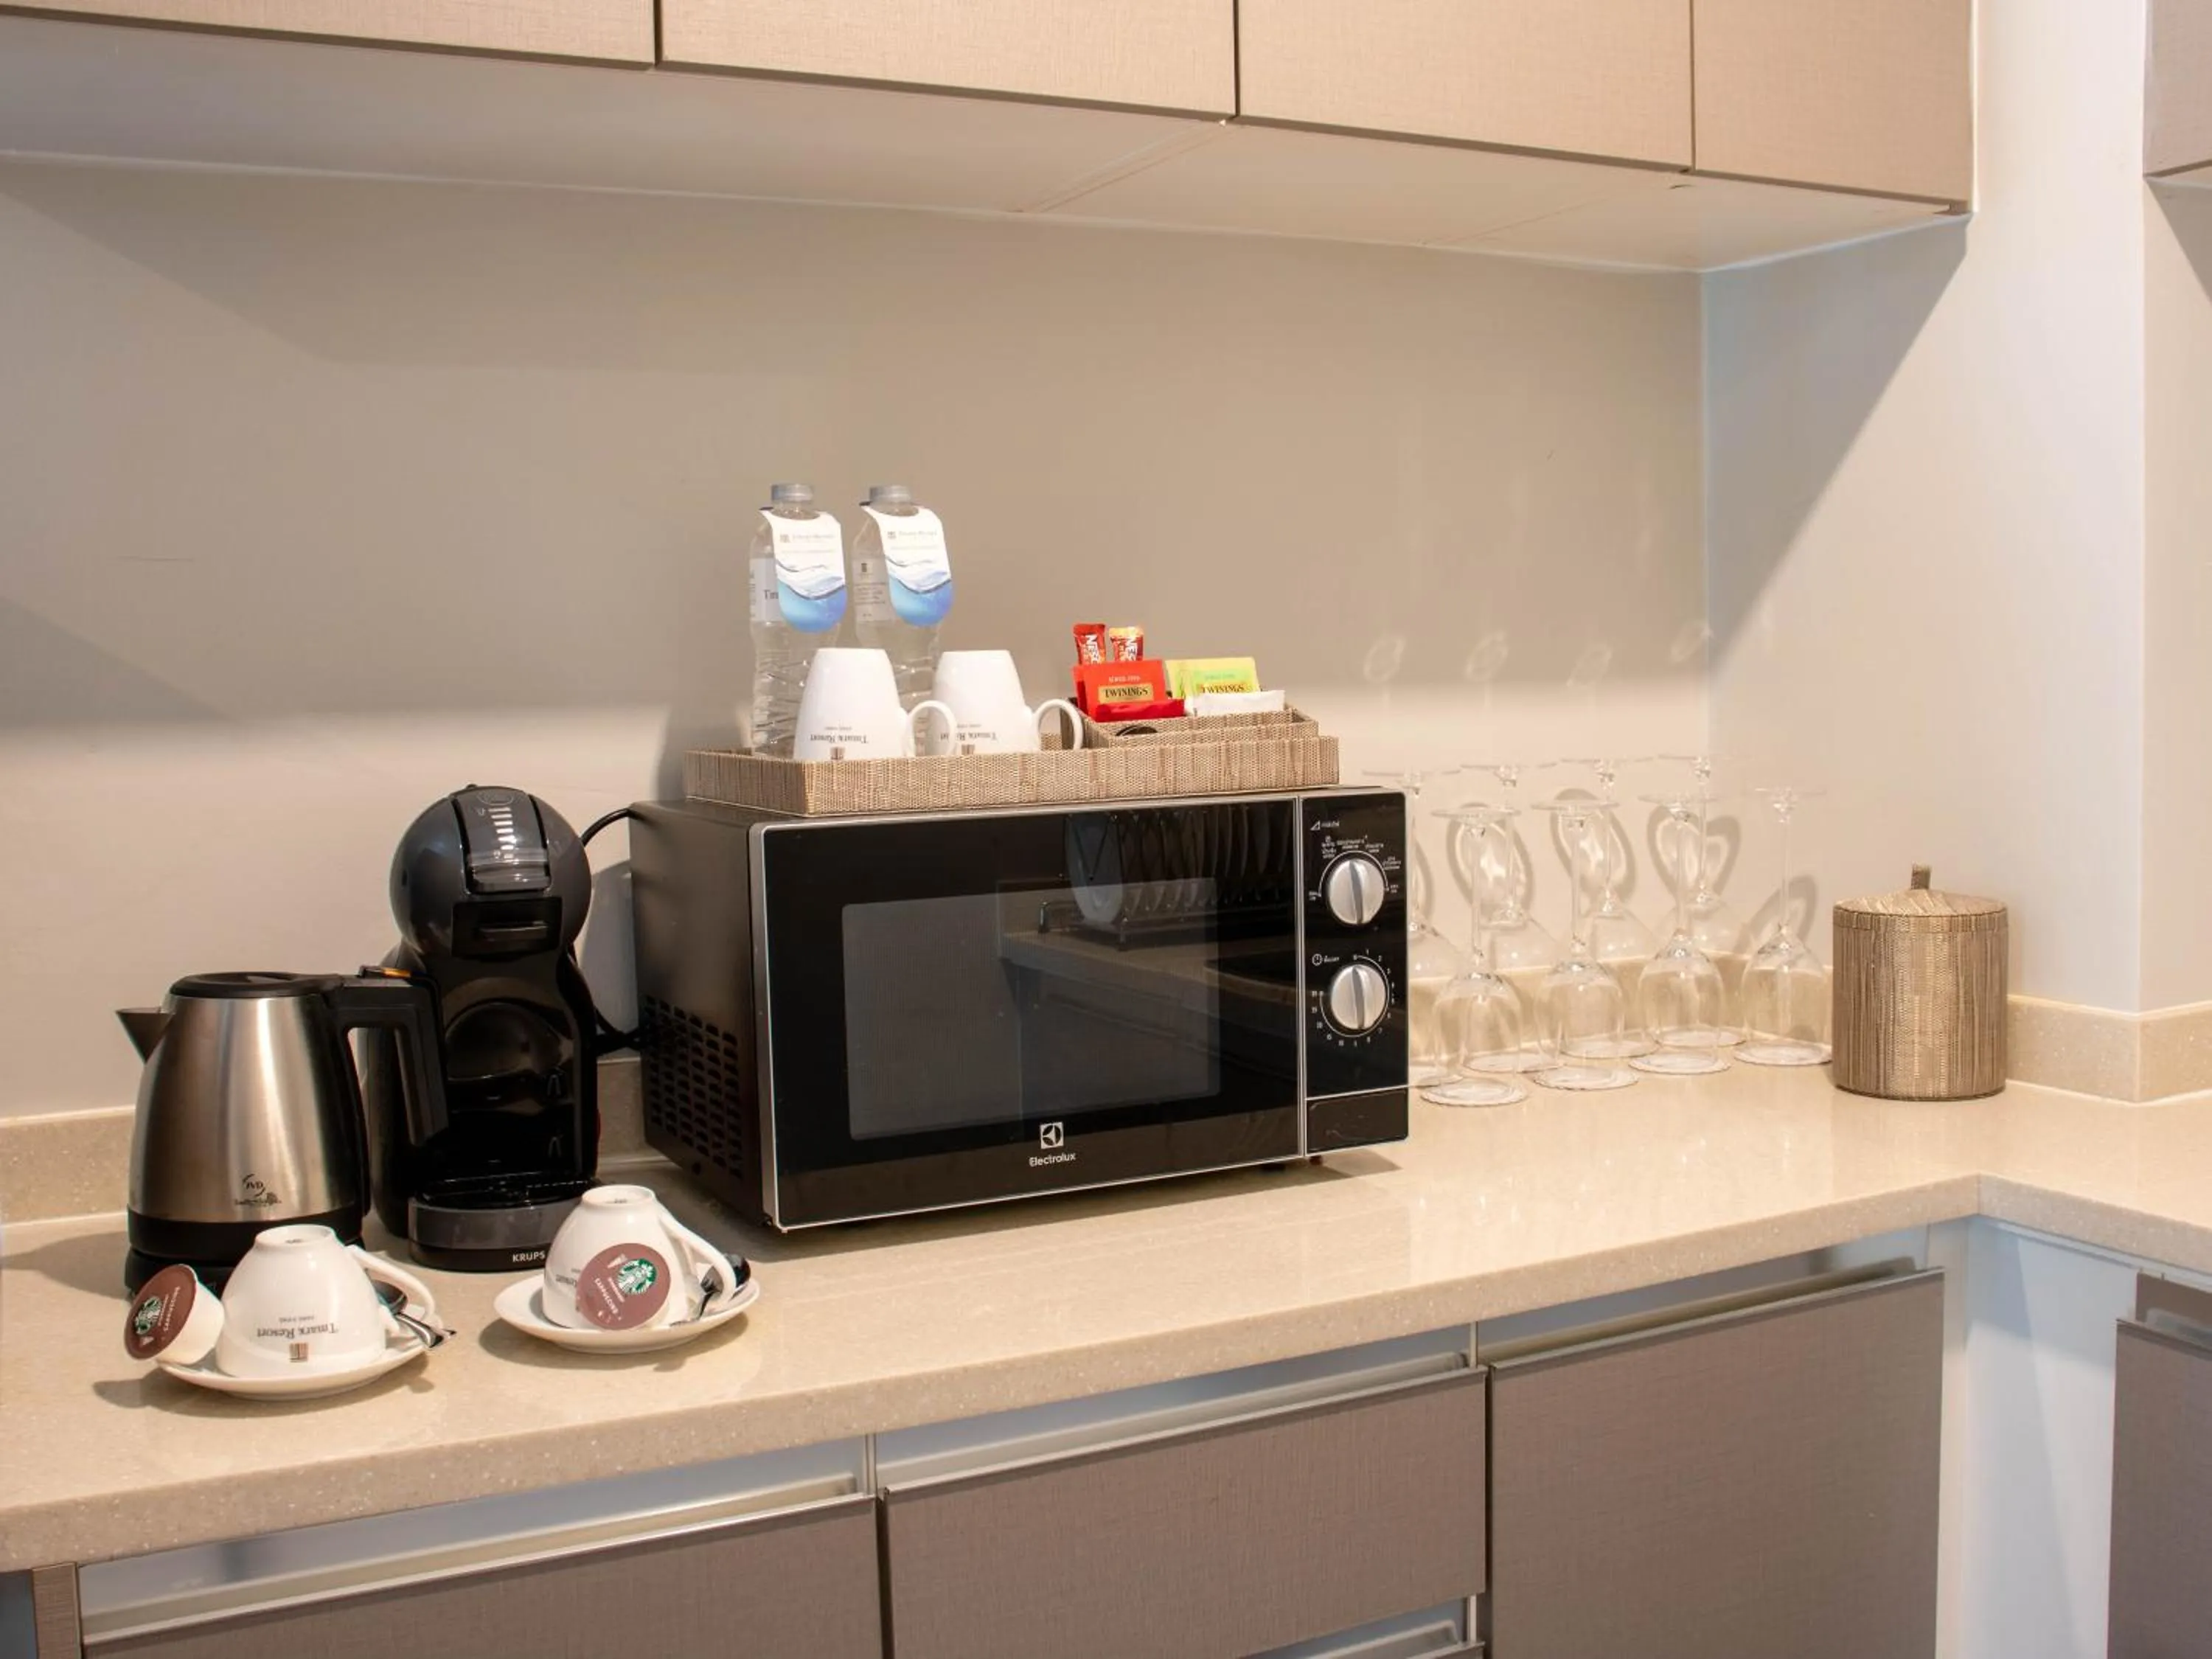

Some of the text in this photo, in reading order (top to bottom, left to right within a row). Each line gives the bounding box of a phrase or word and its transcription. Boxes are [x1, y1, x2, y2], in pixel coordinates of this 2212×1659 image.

[1104, 686, 1149, 699] TWININGS
[1201, 684, 1246, 694] TWININGS
[1029, 1152, 1077, 1167] Electrolux
[512, 1251, 546, 1262] KRUPS
[256, 1322, 339, 1340] Tmark Resort
